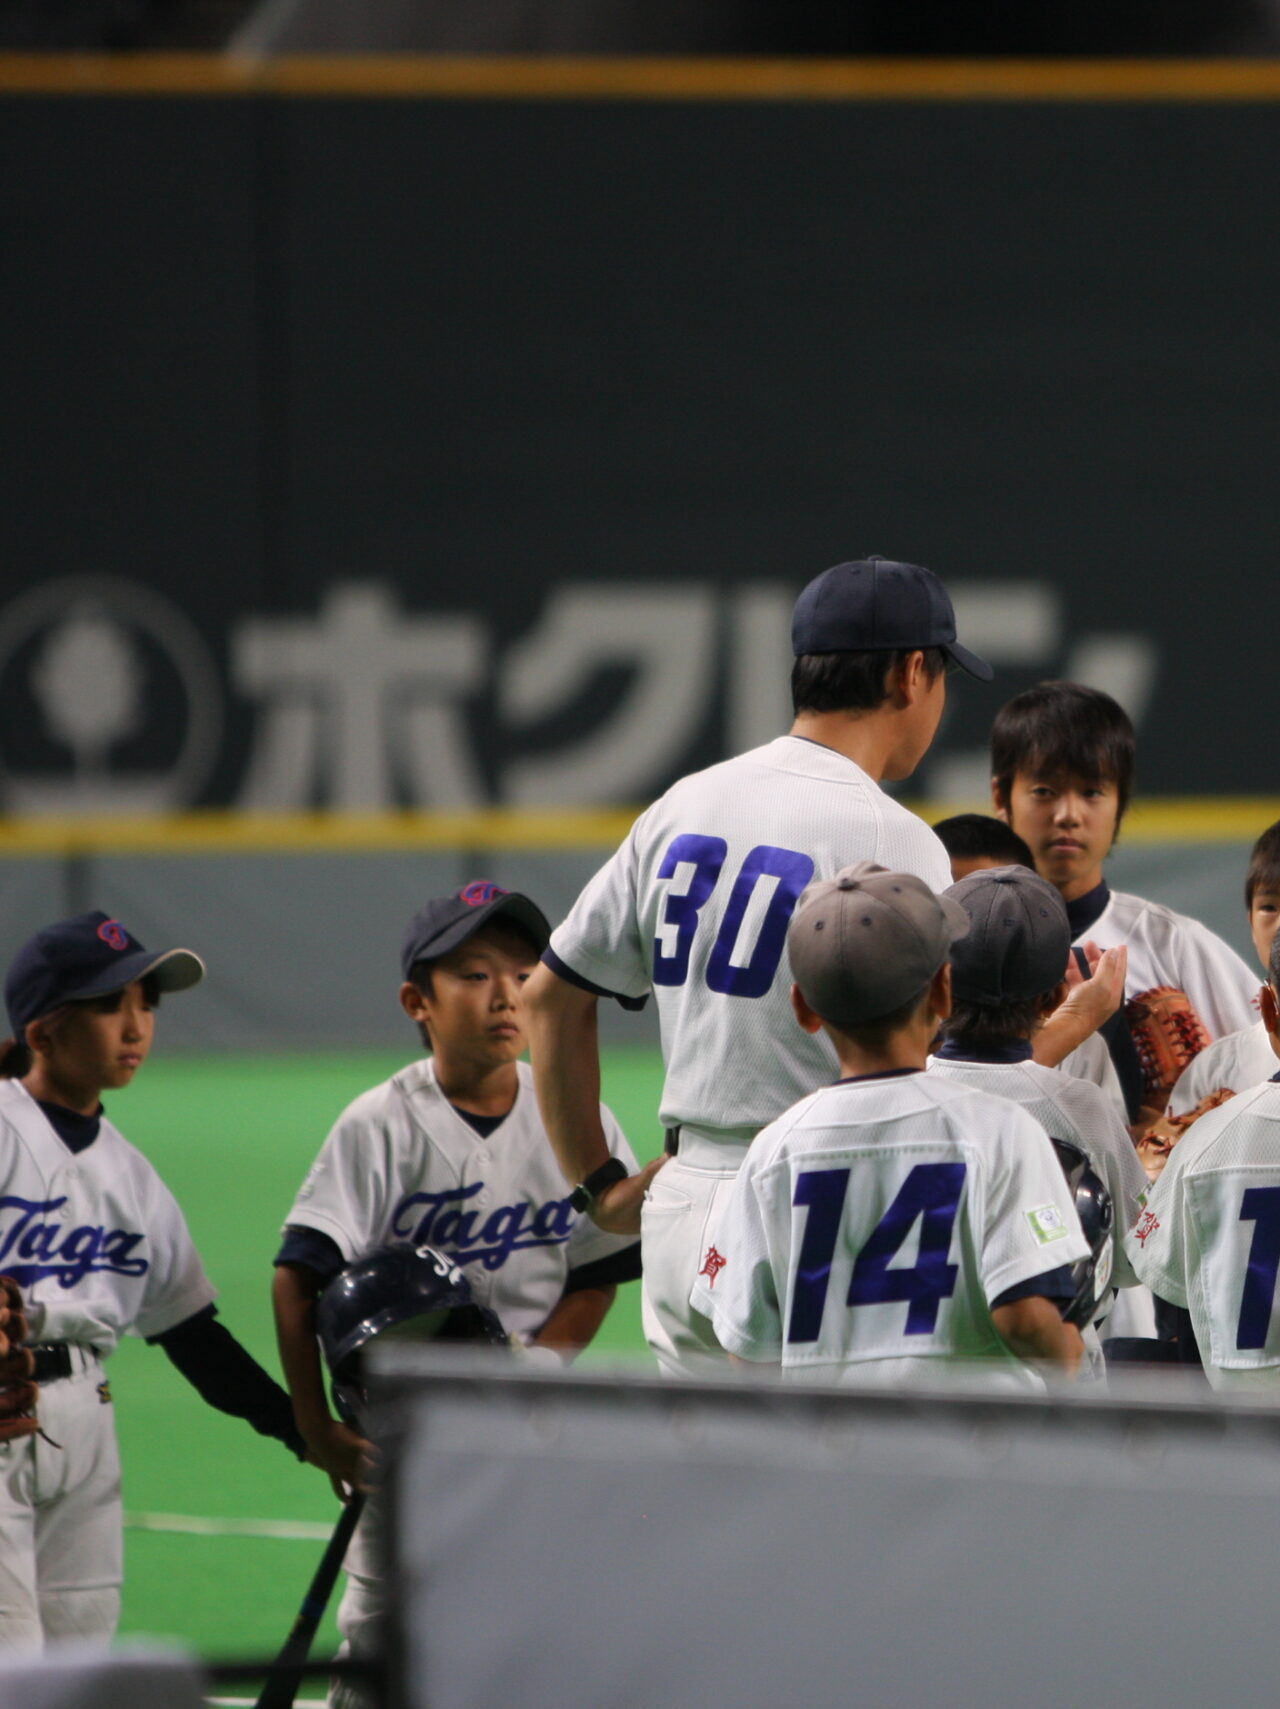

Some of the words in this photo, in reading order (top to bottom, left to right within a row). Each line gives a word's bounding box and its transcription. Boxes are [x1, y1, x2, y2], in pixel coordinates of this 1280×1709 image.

[652, 833, 815, 998] 30
[0, 1196, 149, 1289] Taga
[393, 1181, 575, 1270] Taga
[787, 1162, 967, 1344] 14
